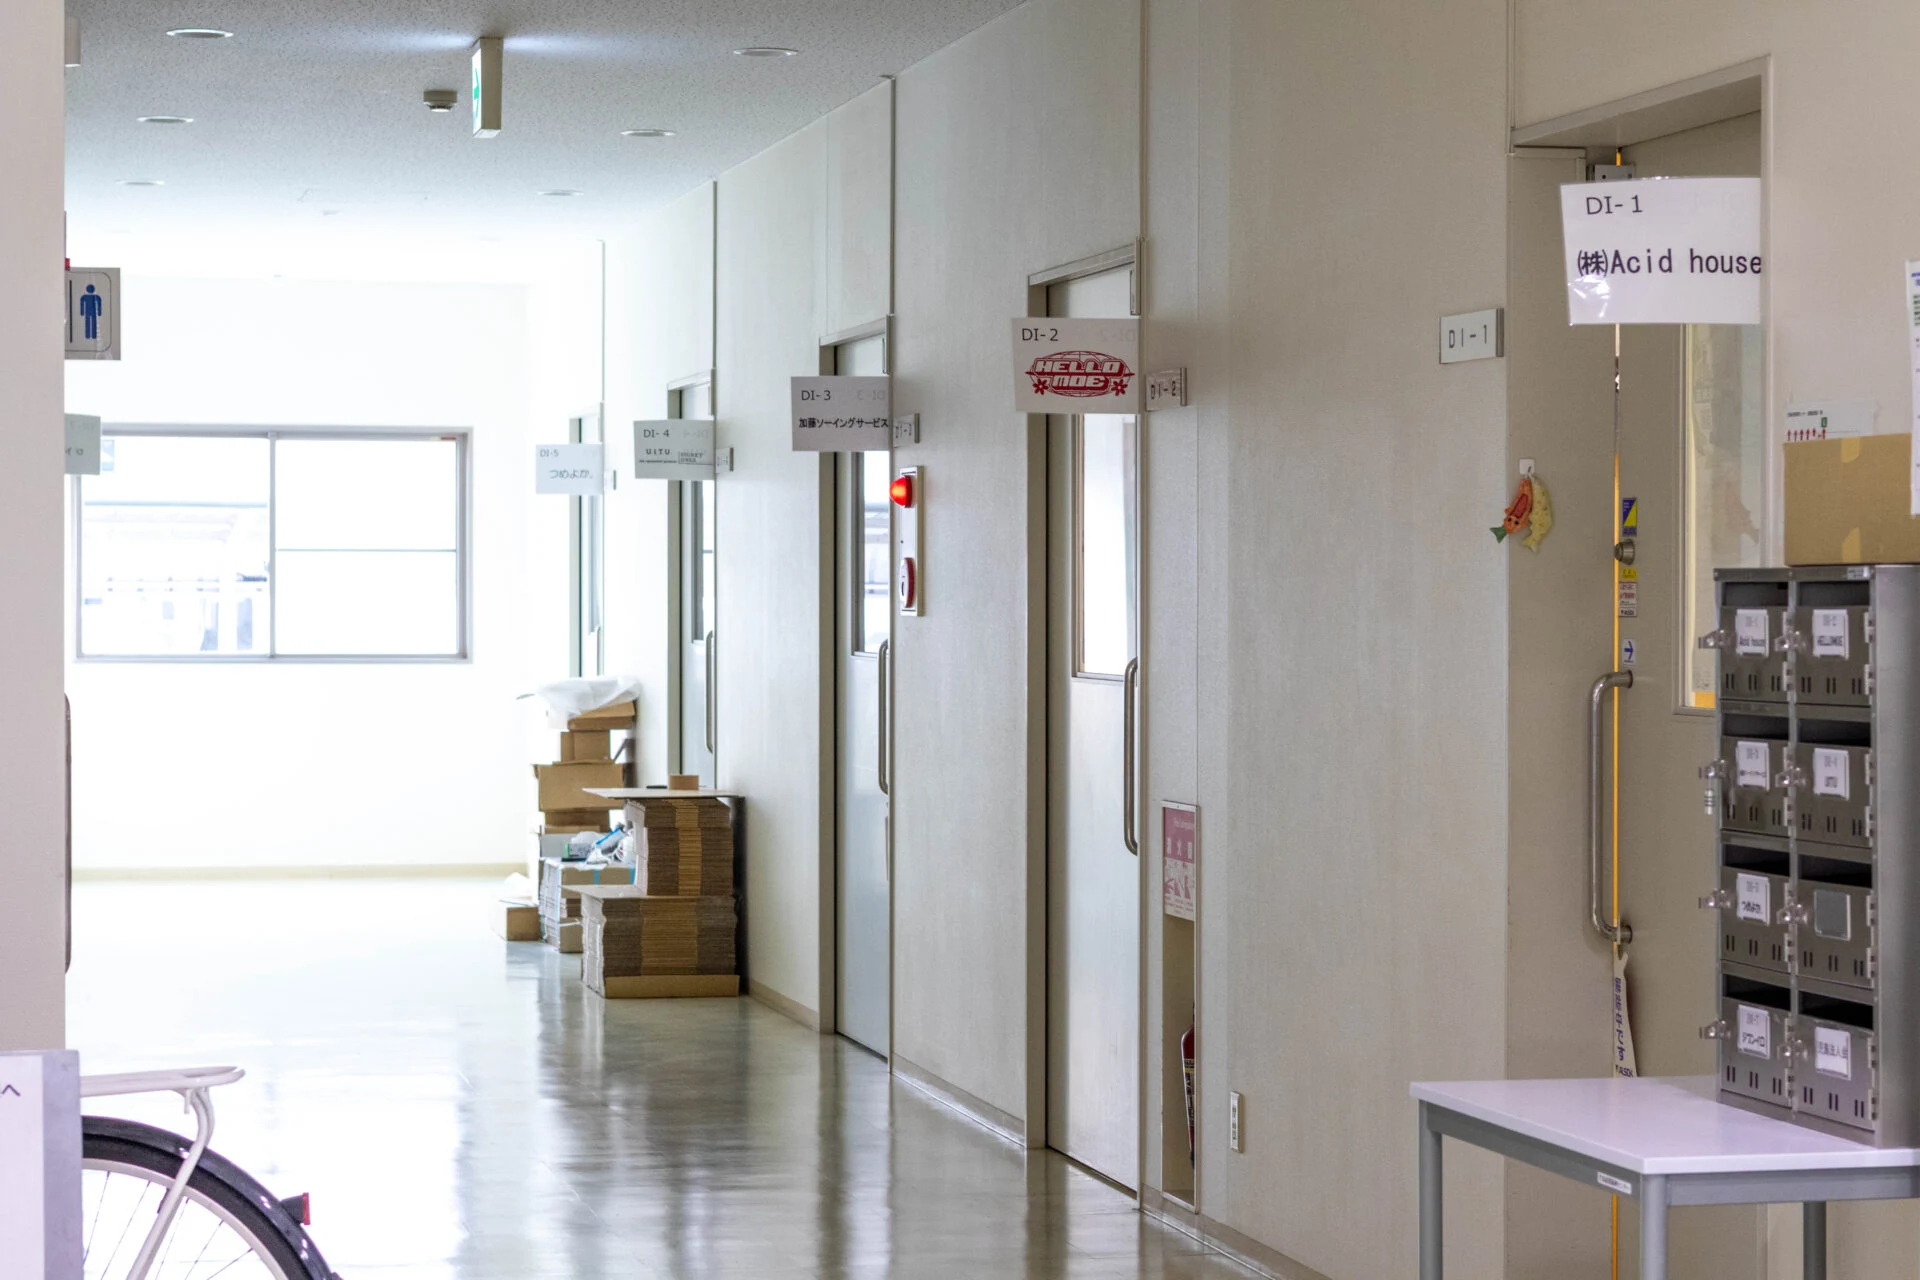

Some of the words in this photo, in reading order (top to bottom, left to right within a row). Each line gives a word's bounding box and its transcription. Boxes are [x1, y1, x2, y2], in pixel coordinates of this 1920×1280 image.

[1689, 248, 1762, 275] house
[1447, 324, 1489, 350] DI-1
[1034, 360, 1123, 374] HELLO
[1052, 375, 1108, 388] MOE
[798, 417, 889, 428] 加藤ソーイングサービス
